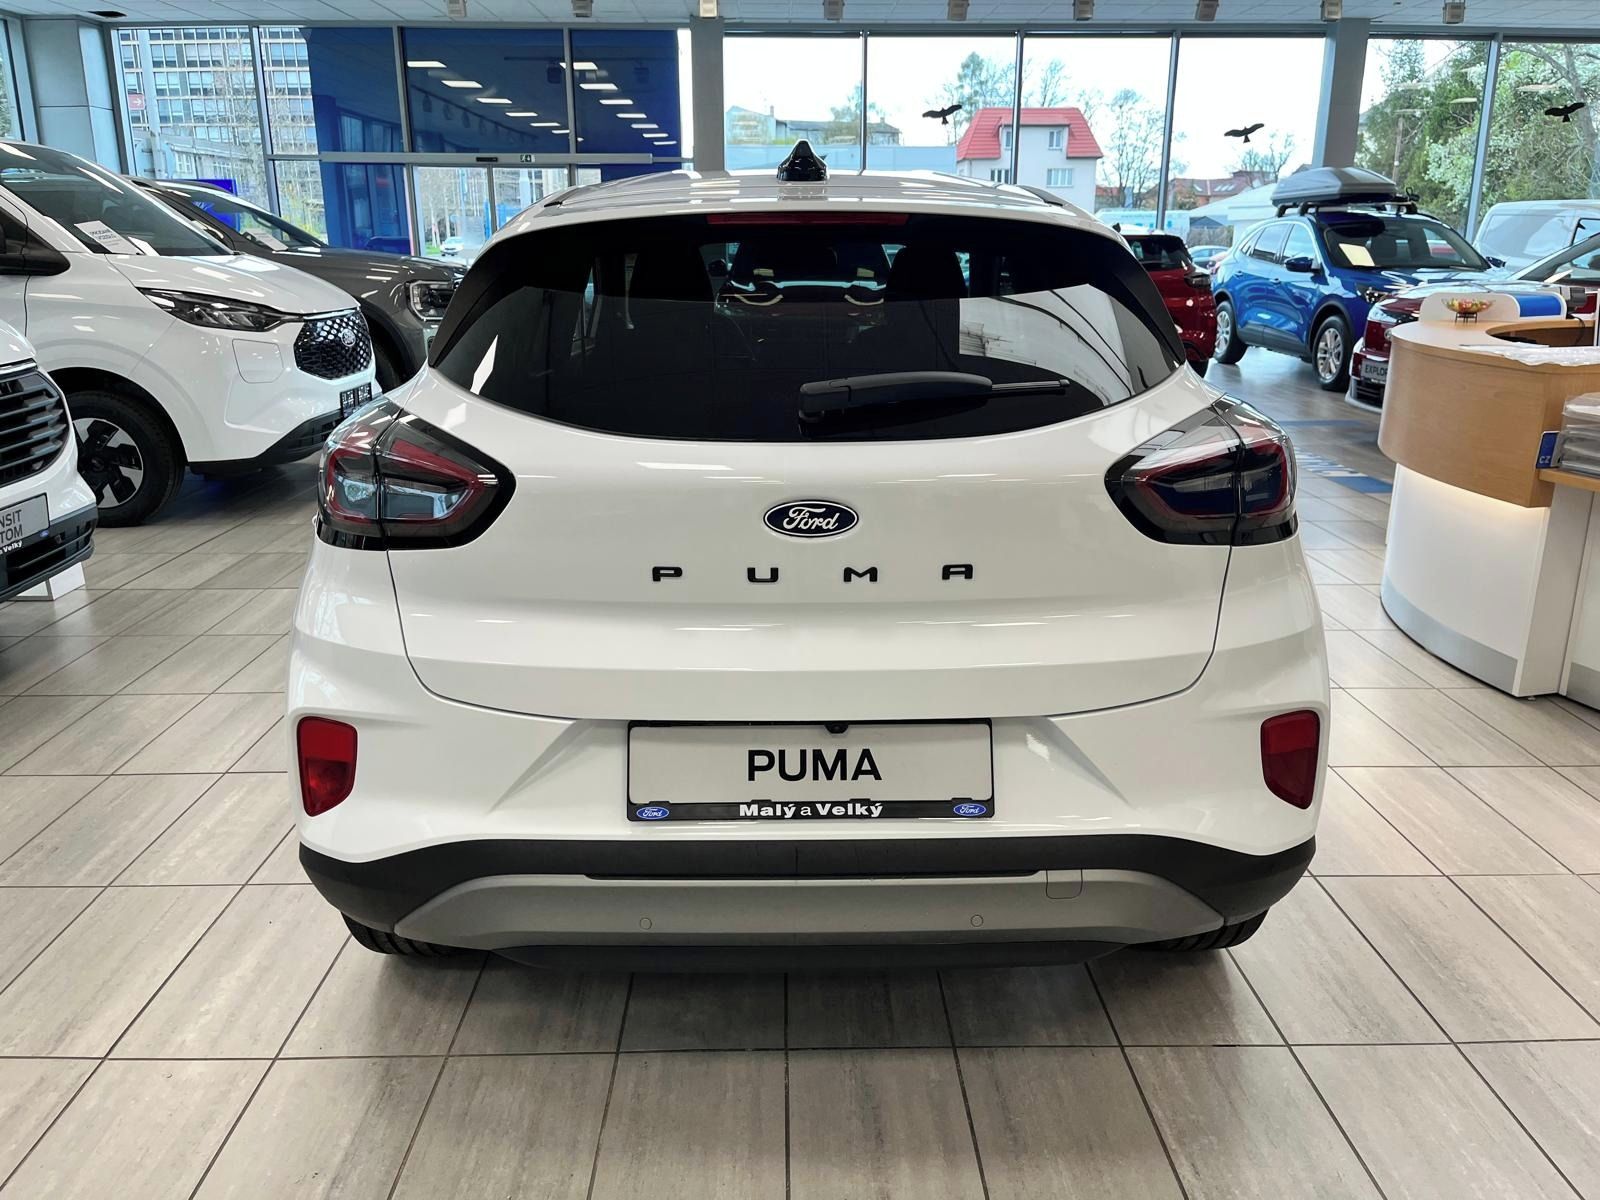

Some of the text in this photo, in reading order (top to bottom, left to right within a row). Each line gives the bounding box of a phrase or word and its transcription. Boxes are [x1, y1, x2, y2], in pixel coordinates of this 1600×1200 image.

[1539, 455, 1551, 463] CZ
[783, 507, 840, 529] Ford
[652, 564, 973, 582] PUMA
[748, 749, 881, 781] PUMA
[642, 807, 663, 816] Ford
[740, 803, 883, 818] Malý a Velký
[960, 805, 979, 814] Ford
